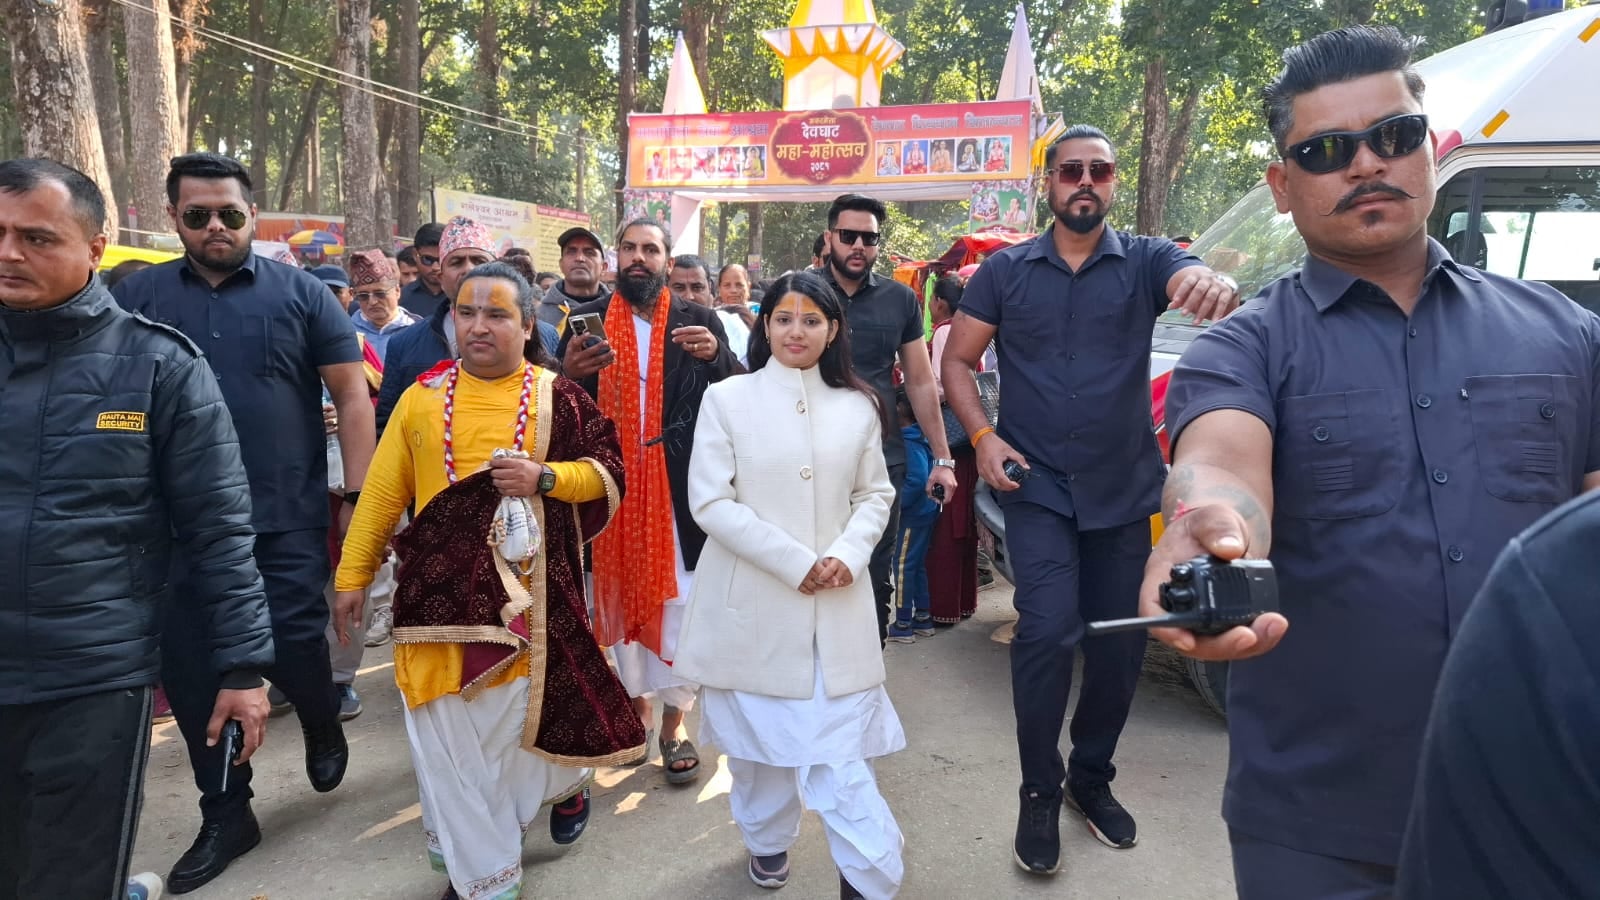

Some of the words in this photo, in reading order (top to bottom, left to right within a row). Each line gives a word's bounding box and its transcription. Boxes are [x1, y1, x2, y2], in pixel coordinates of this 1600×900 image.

[801, 122, 840, 139] देवघाट
[810, 162, 830, 173] २०८१
[100, 420, 141, 428] SECURITY
